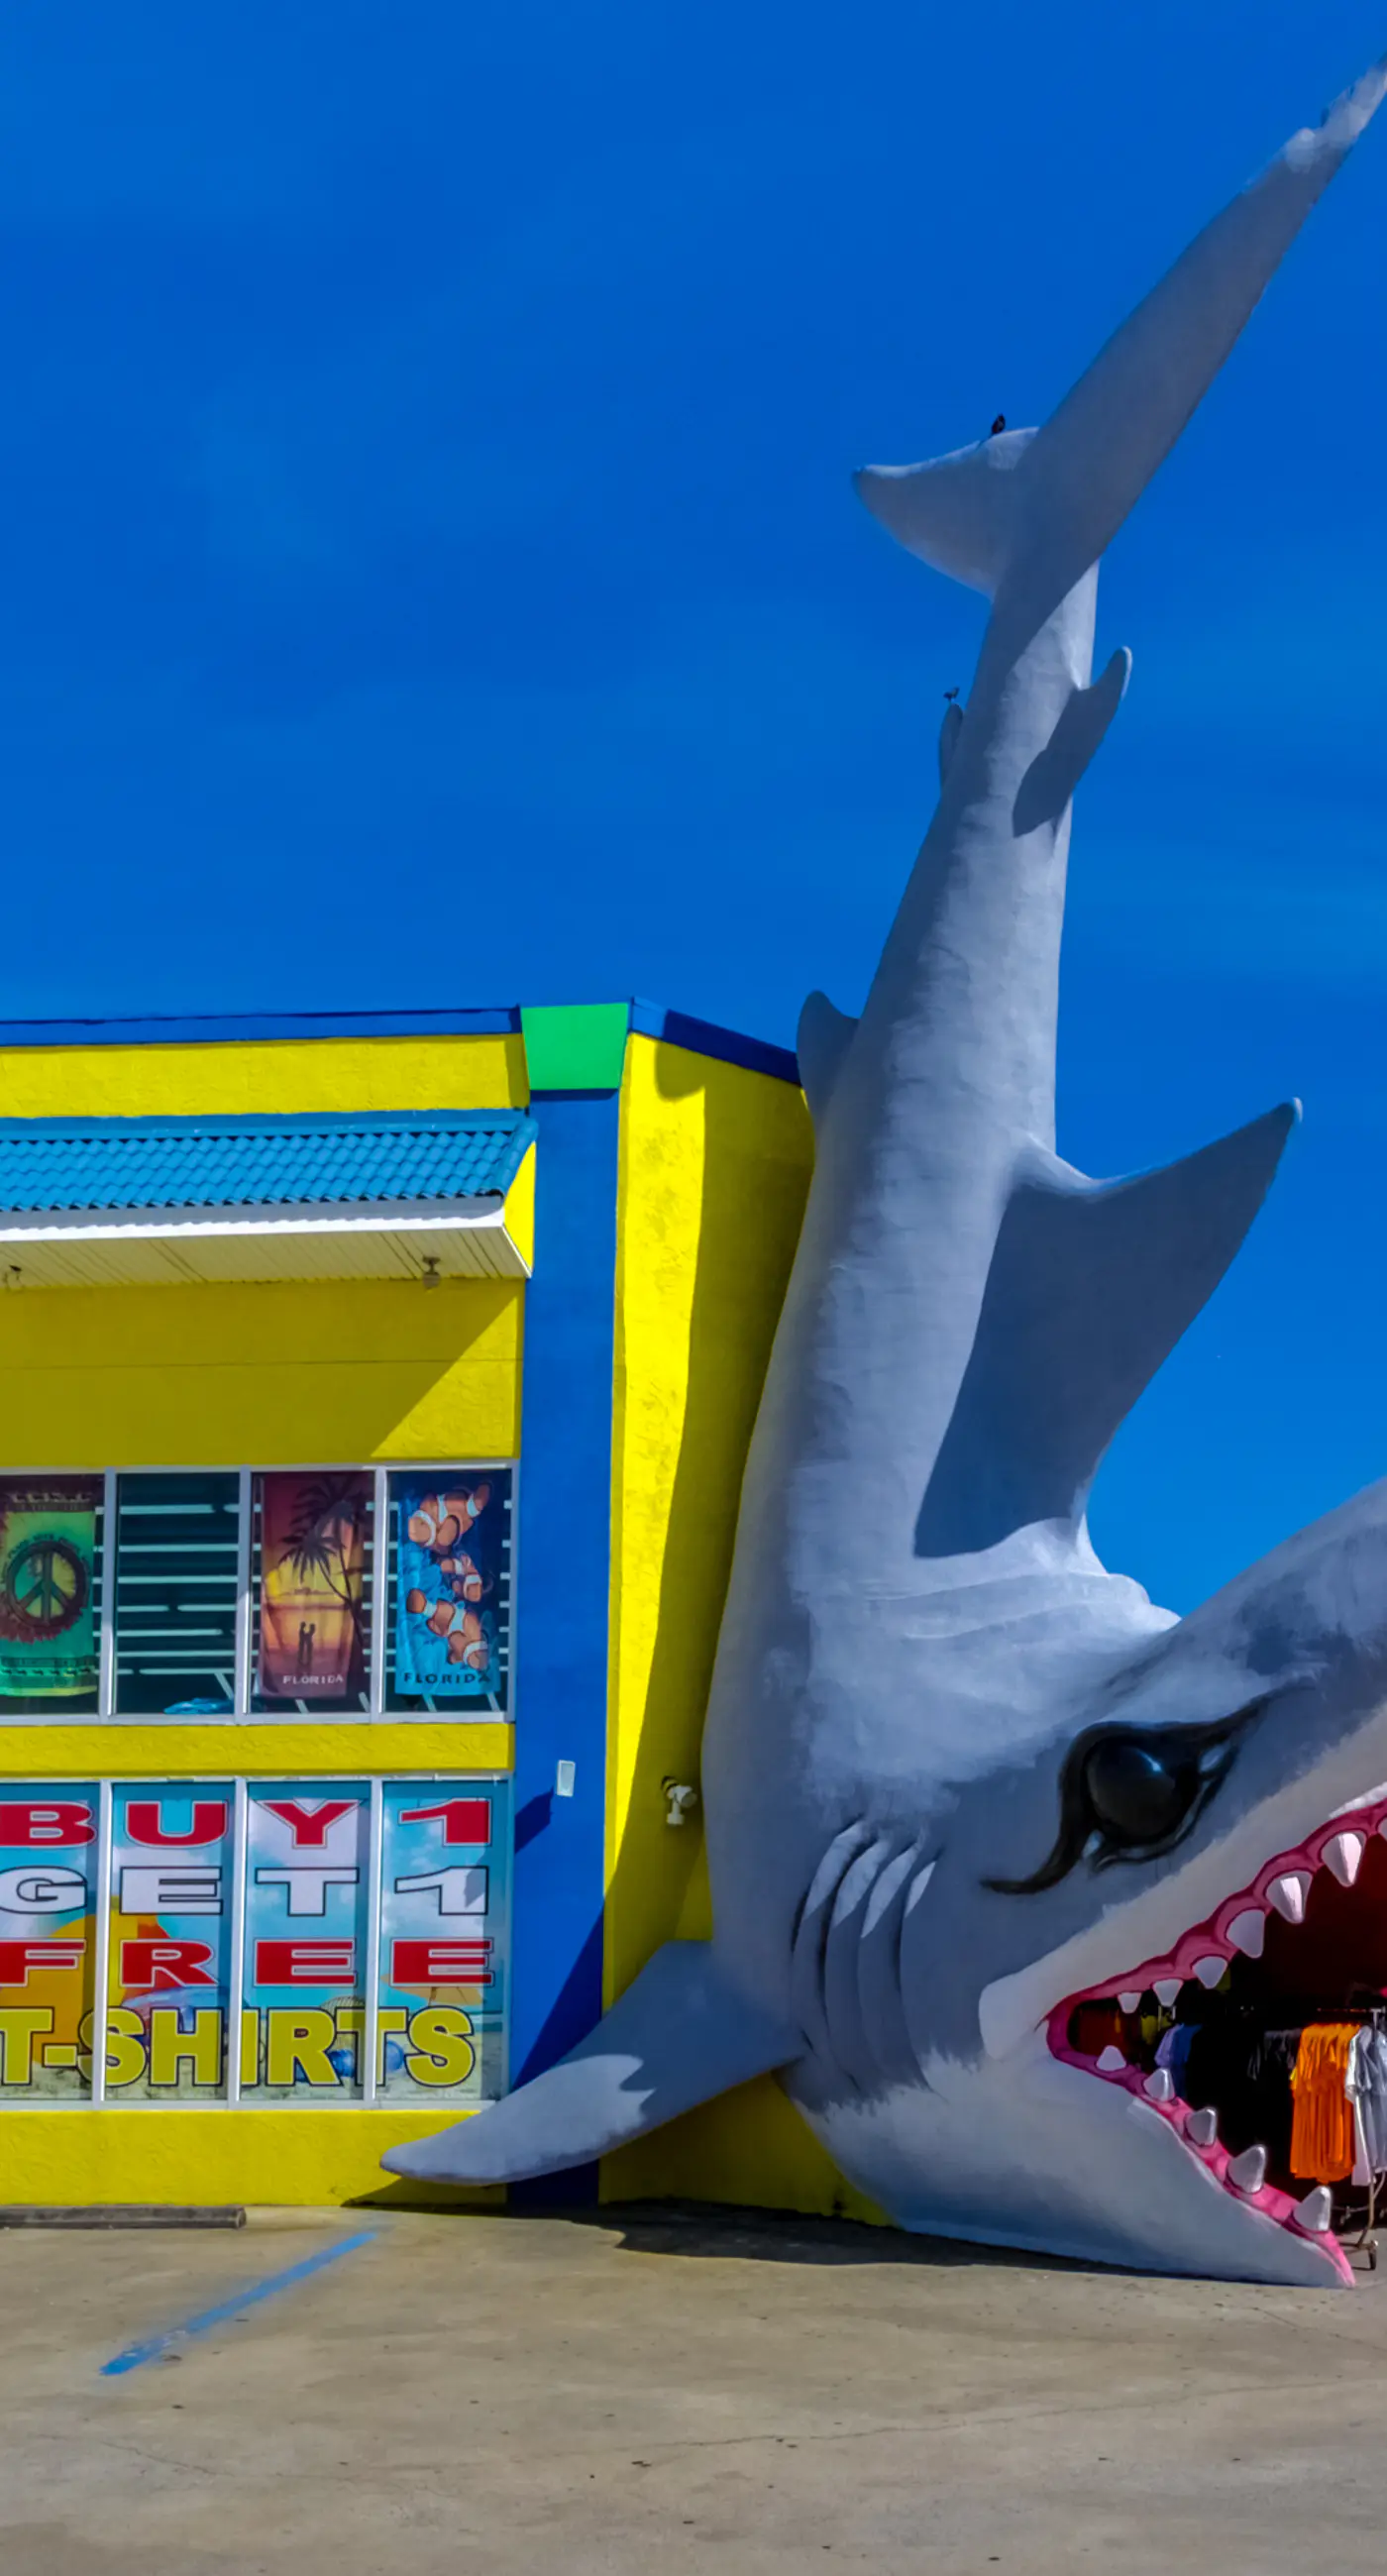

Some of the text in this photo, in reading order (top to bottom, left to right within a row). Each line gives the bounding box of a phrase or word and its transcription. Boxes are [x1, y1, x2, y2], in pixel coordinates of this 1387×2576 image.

[282, 1673, 344, 1685] FLORIDA
[403, 1671, 491, 1684] FLORIDA
[0, 1797, 491, 1848] BUY 1
[0, 1866, 488, 1915] GET 1
[0, 1938, 493, 1987] FREE
[0, 2005, 476, 2088] T-SHIRTS
